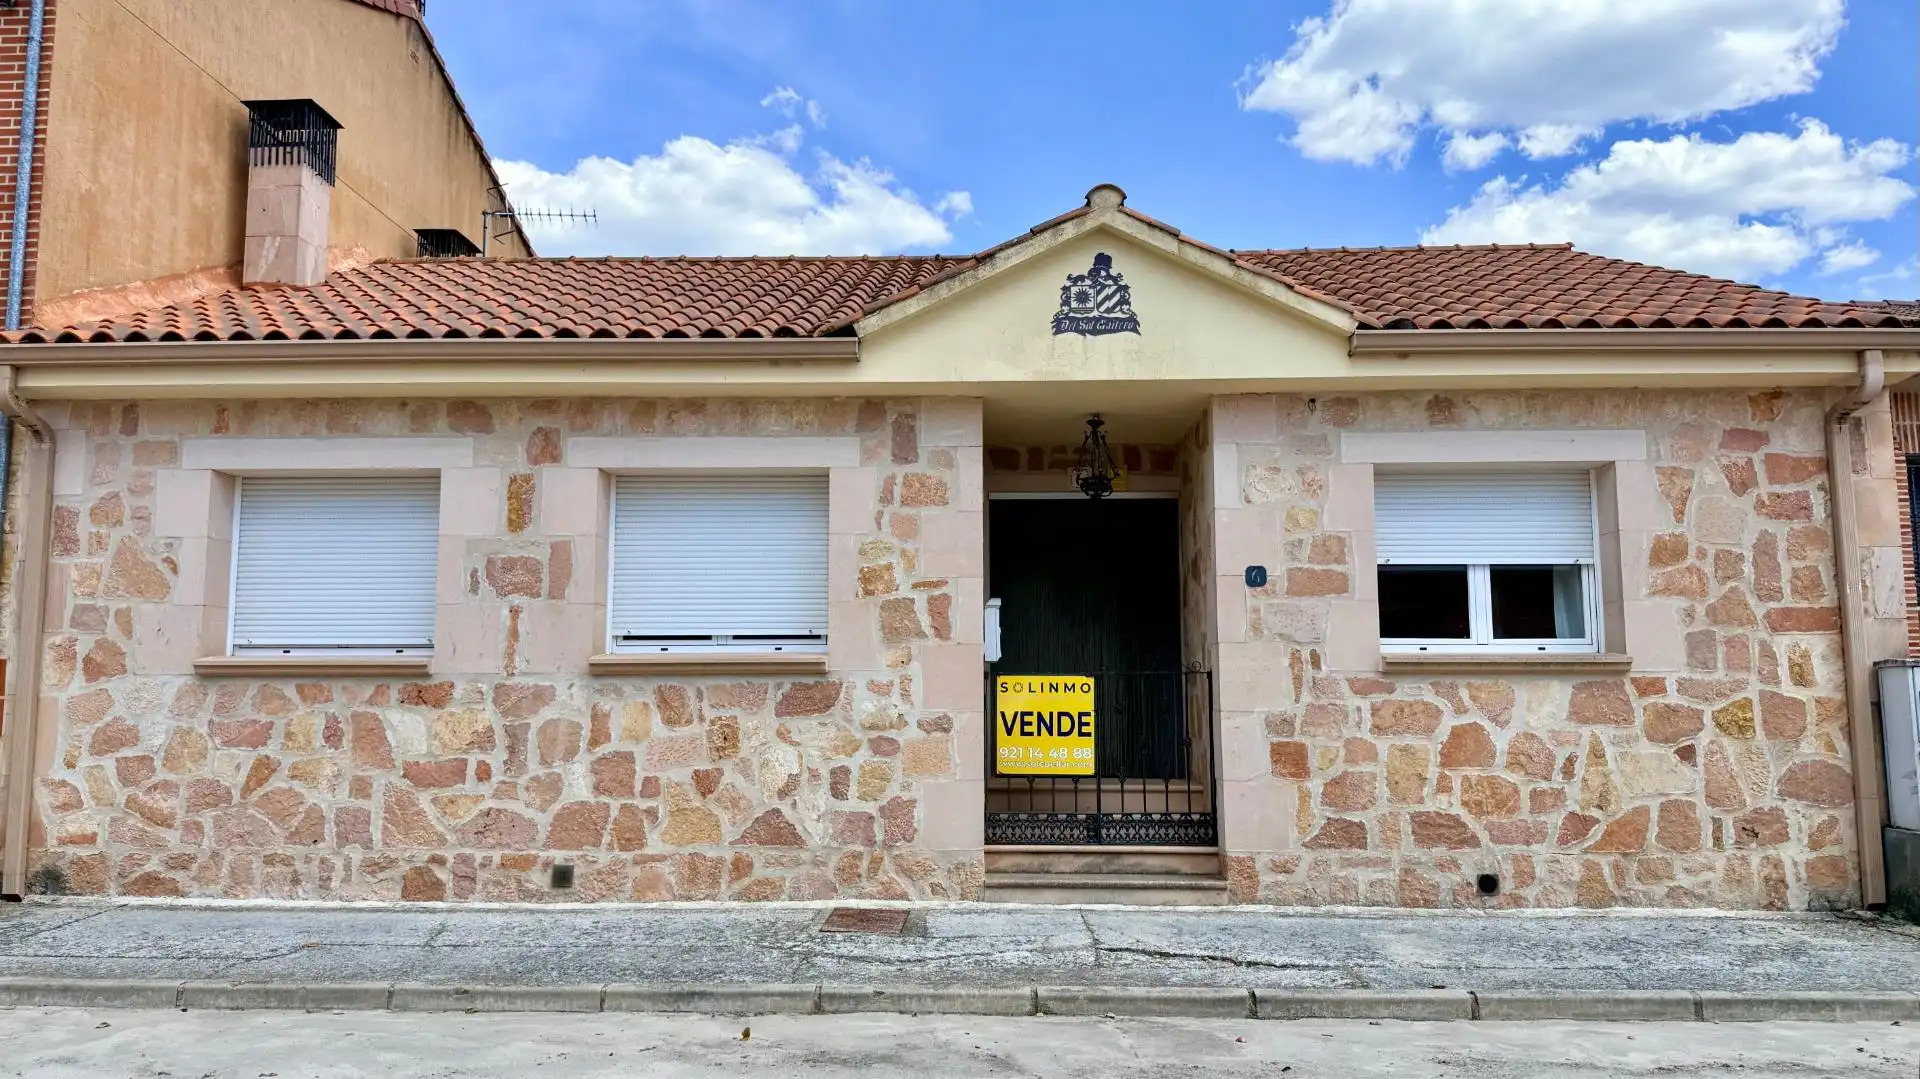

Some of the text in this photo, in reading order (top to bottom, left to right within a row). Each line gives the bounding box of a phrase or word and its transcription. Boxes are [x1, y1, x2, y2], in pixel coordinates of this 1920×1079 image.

[1000, 682, 1091, 693] SOLINMO
[1000, 711, 1092, 737] VENDE
[1000, 747, 1092, 759] 921 14 48 88
